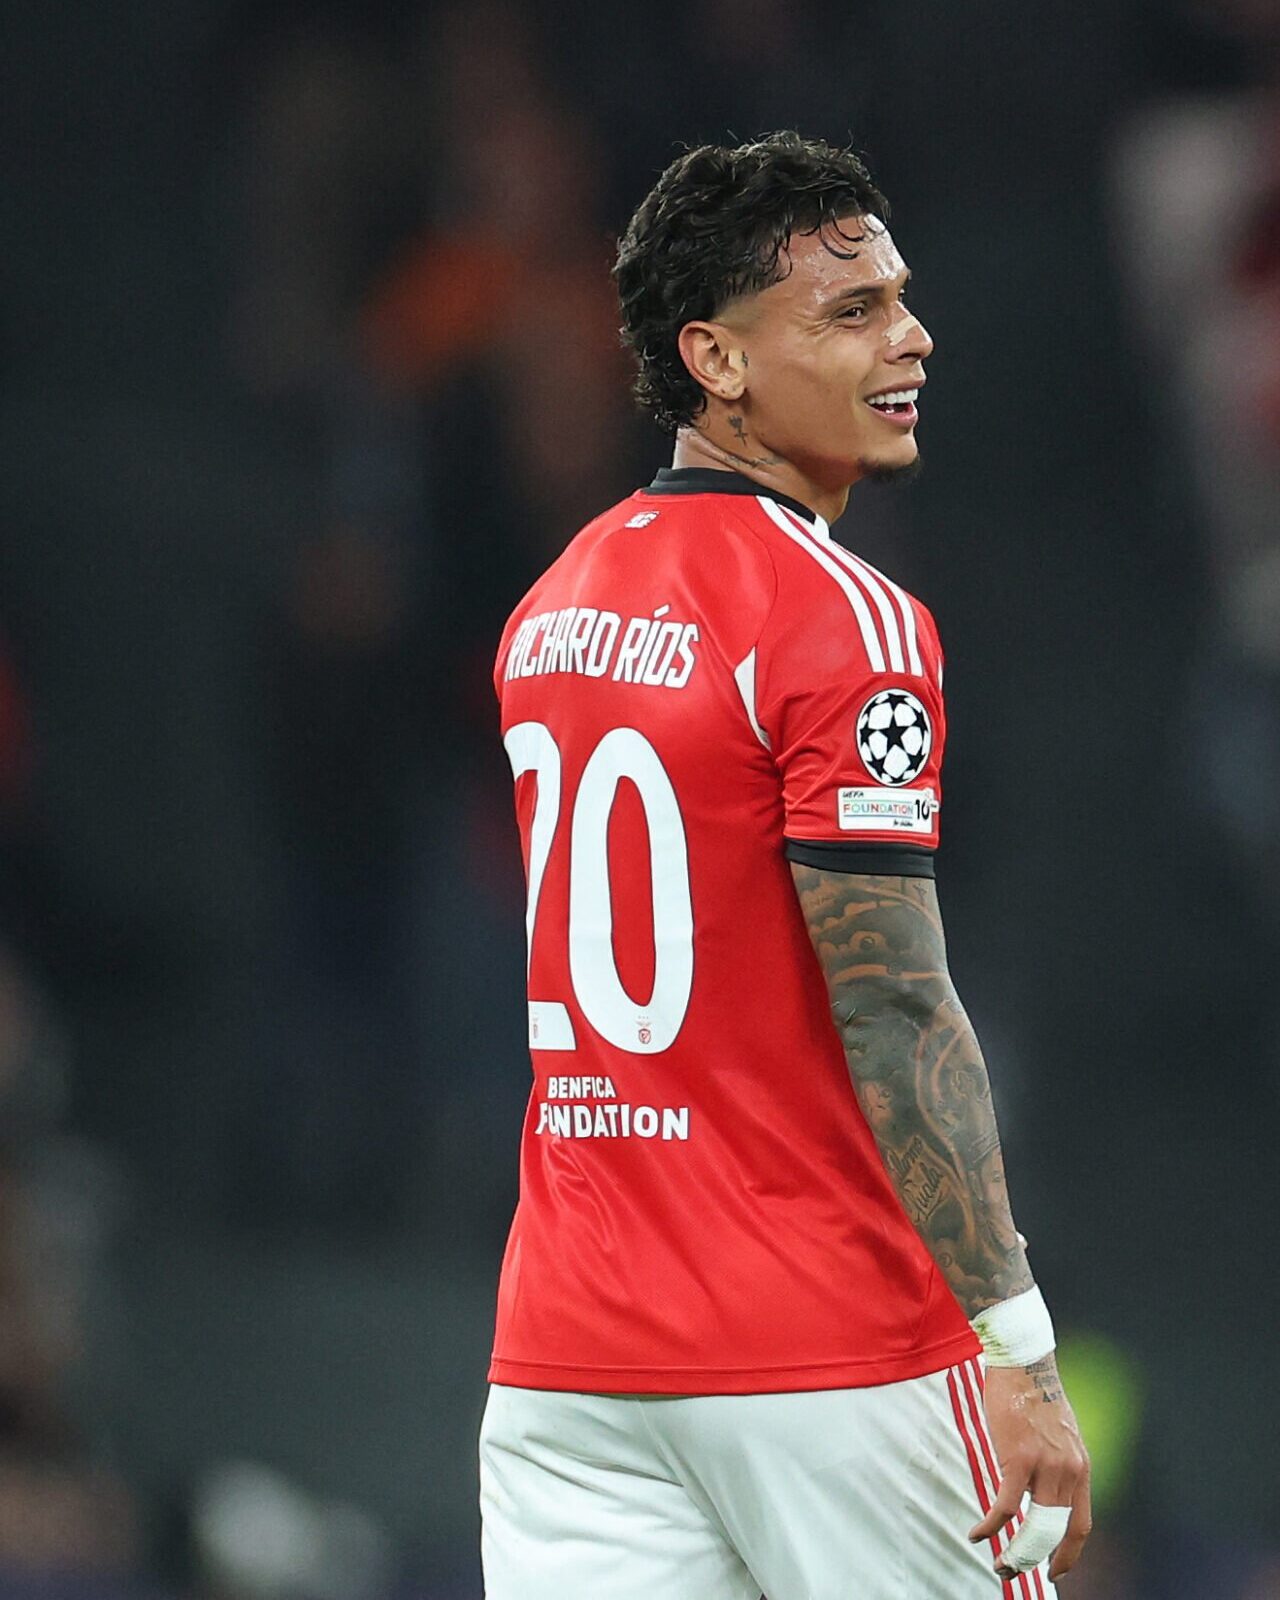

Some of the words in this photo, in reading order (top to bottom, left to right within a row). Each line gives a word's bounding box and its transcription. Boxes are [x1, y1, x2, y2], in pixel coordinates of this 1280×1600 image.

[612, 604, 699, 688] RÍOS
[843, 803, 913, 815] FOUNDATION
[504, 721, 694, 1054] 20
[547, 1076, 616, 1099] BENFICA
[535, 1102, 688, 1140] FUNDATION
